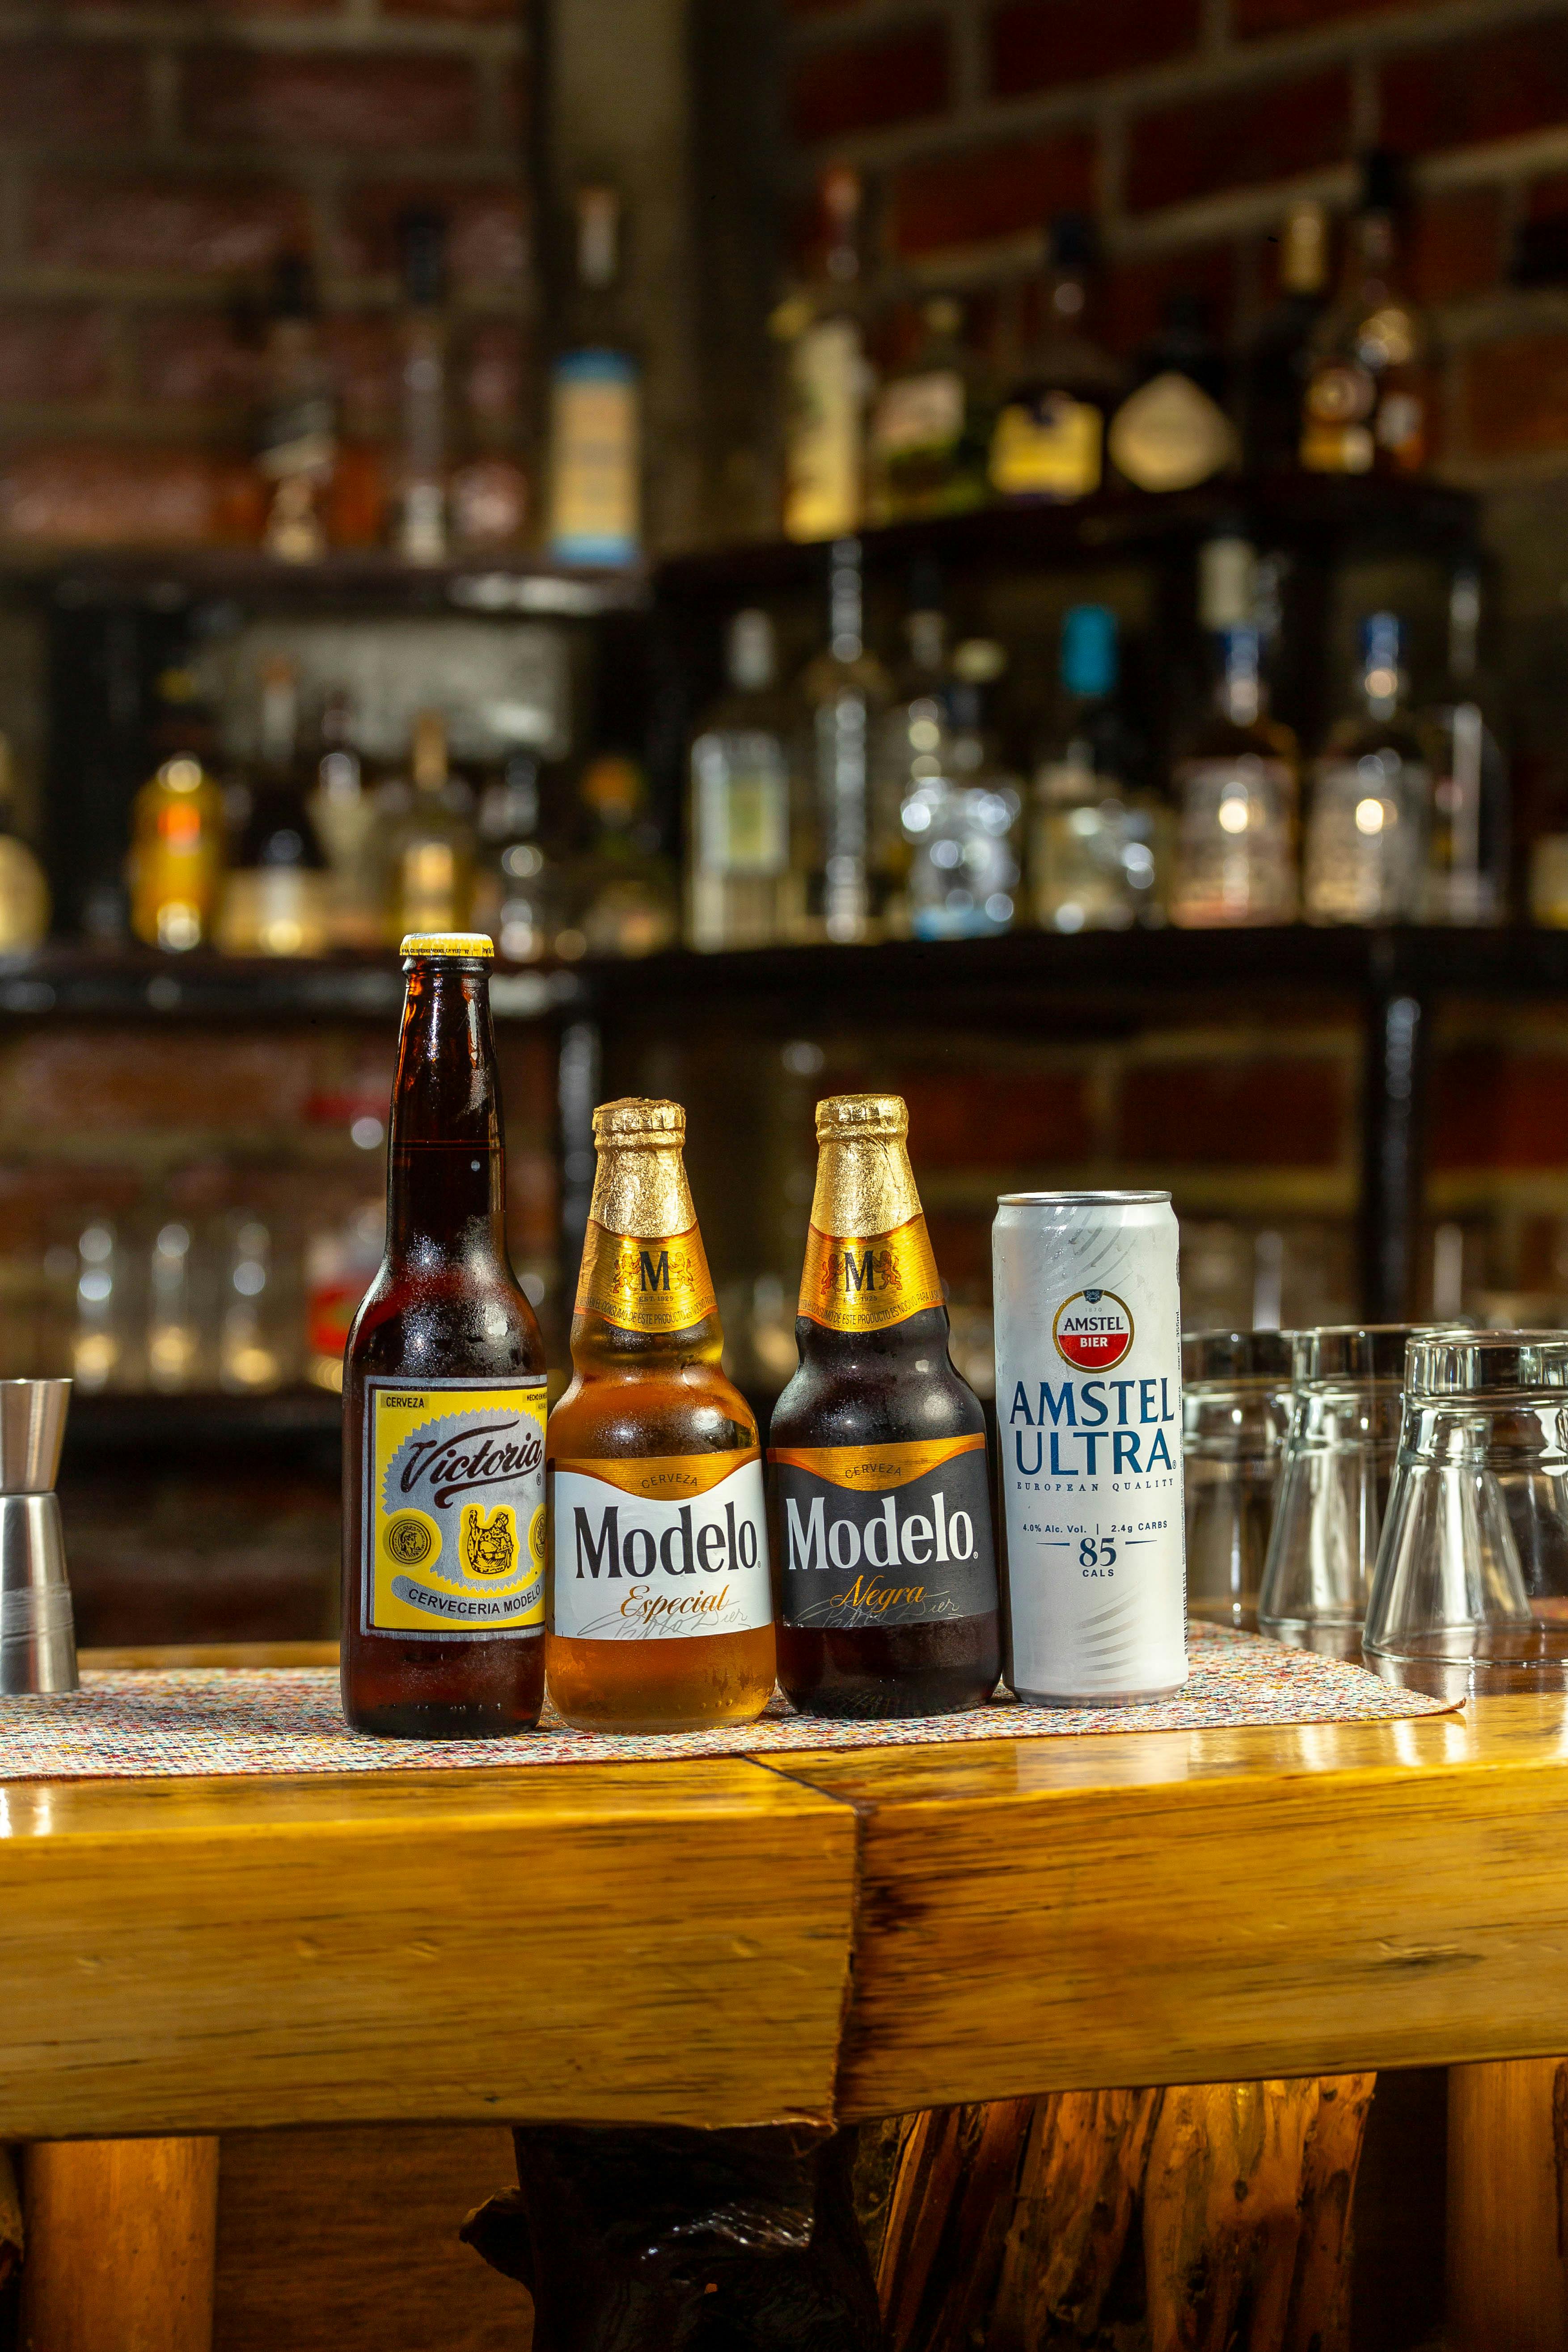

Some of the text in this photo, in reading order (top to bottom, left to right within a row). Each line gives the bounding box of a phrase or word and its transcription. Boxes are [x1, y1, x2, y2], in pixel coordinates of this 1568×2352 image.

[639, 1251, 670, 1291] M
[843, 1250, 876, 1292] M
[638, 1313, 652, 1325] ESTE
[654, 1310, 685, 1325] PRODUCTO
[811, 1302, 833, 1322] CONSUMO
[833, 1312, 841, 1323] DE
[842, 1314, 856, 1325] ESTE
[858, 1310, 891, 1325] PRODUCTO
[890, 1306, 899, 1318] ES
[897, 1296, 917, 1314] NOCIVO
[917, 1292, 929, 1304] PARA
[1063, 1317, 1124, 1331] AMSTEL
[1080, 1337, 1108, 1347] BIER
[386, 1397, 425, 1408] CERVEZA
[1009, 1377, 1175, 1427] AMSTEL
[400, 1419, 542, 1509] Victoria
[1015, 1428, 1173, 1475] ULTRA
[642, 1473, 697, 1489] CERVEZA
[845, 1463, 901, 1479] CERVEZA
[1017, 1478, 1173, 1491] EUROPEAN QUALITY
[573, 1501, 758, 1579] Modelo
[786, 1492, 973, 1570] Modelo
[1023, 1520, 1167, 1533] 4.0% Alc. Vol. 2.4g CARBS
[1079, 1537, 1117, 1567] 85
[1082, 1569, 1114, 1577] CALS
[408, 1584, 541, 1614] CERVECERIA MODELO
[620, 1584, 730, 1624] Especial
[830, 1575, 928, 1613] Negra
